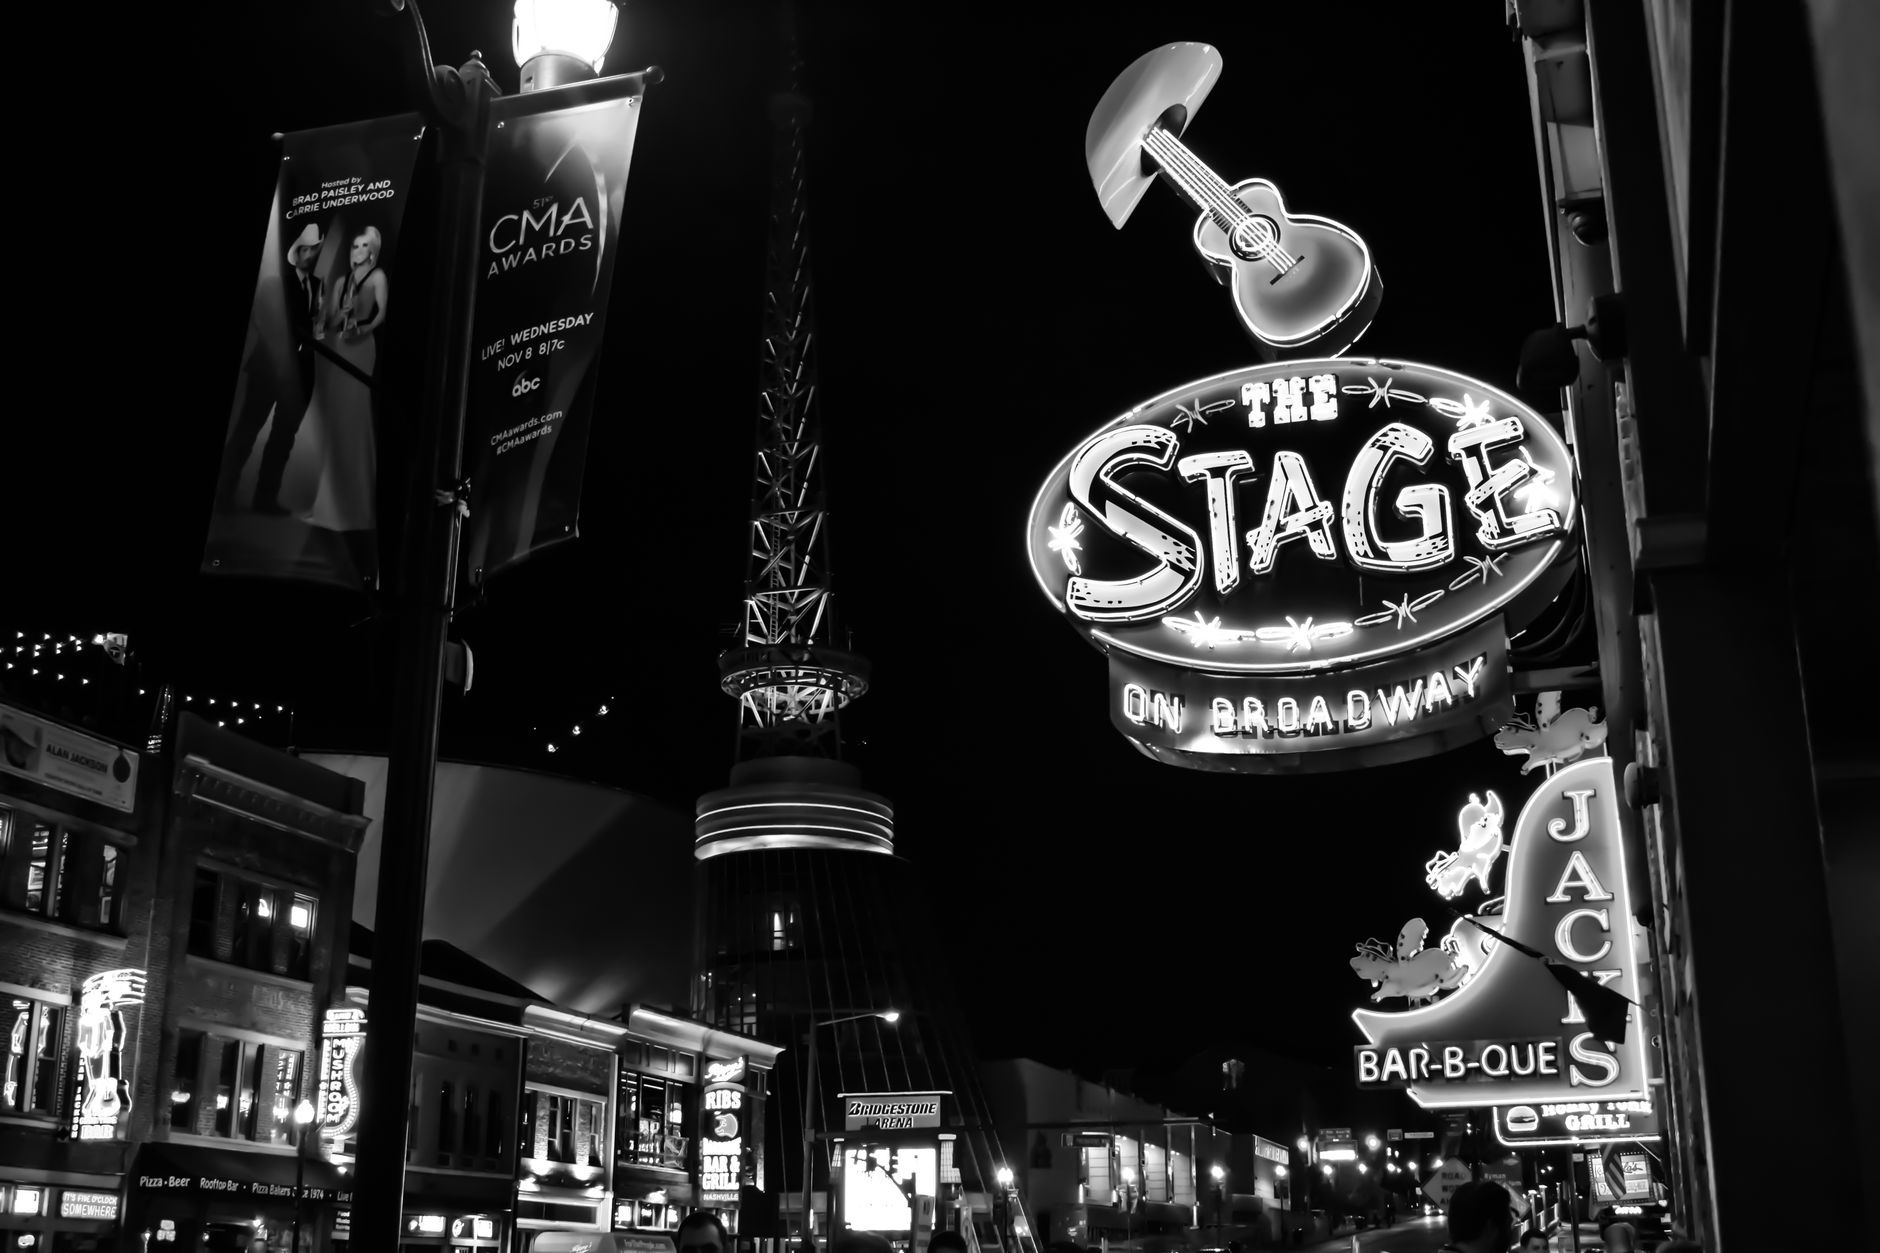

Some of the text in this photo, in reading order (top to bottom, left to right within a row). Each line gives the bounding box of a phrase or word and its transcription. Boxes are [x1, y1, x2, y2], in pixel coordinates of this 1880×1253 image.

[292, 180, 391, 207] BRAD PAISLEY AND
[321, 176, 362, 188] Hosted by
[286, 189, 395, 219] CARRIE UNDERWOOD
[489, 197, 594, 253] CMA
[487, 234, 592, 280] AWARDS
[481, 312, 594, 361] LIVE! WEDNESDAY
[497, 350, 523, 372] NOV
[525, 347, 532, 360] 8
[511, 377, 541, 397] abc
[1241, 373, 1338, 429] THE
[490, 410, 563, 446] CMAawards.com
[496, 424, 552, 456] #CMAawards
[1065, 416, 1562, 622] STAGE
[1123, 655, 1485, 738] ON BROADWAY
[1358, 1042, 1558, 1083] BAR-B-QUE
[326, 1038, 345, 1124] MUSHROOM
[705, 1089, 741, 1110] RIBS
[848, 1101, 938, 1117] BRIDGESTONE
[1565, 1114, 1631, 1131] GRILL
[703, 1155, 741, 1173] BAR &
[140, 1176, 190, 1187] Pizza Beer
[200, 1177, 239, 1191] Rooftop Bar
[252, 1183, 268, 1194] Pizza
[310, 1187, 324, 1199] 1974
[702, 1172, 740, 1190] GRILL
[703, 1192, 739, 1201] NASHVILLE
[63, 1203, 117, 1217] SOMEWHERE
